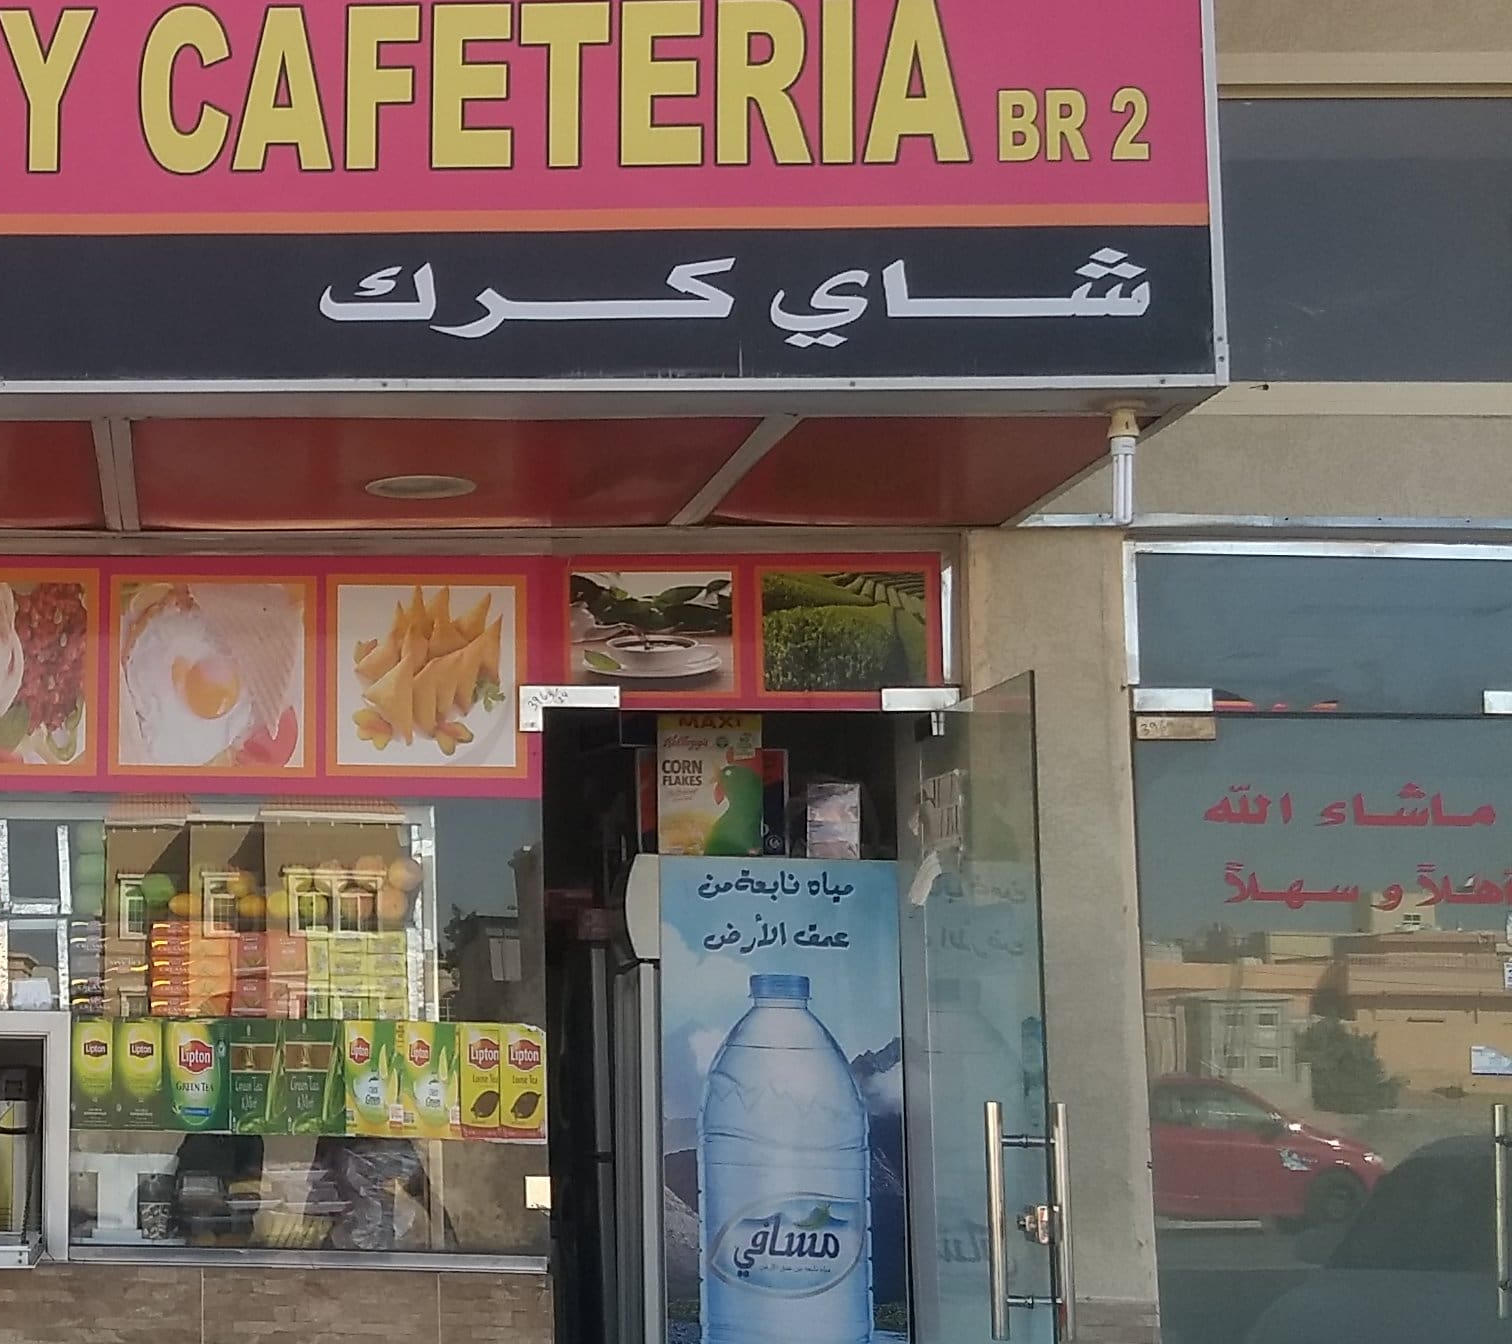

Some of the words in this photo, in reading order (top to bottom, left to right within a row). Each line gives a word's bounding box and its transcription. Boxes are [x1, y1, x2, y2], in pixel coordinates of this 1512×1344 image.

[995, 87, 1090, 163] BR
[1109, 85, 1151, 163] 2
[318, 256, 738, 337] كرك
[769, 244, 1152, 349] شاي
[662, 759, 702, 774] CORN
[662, 775, 702, 786] FLAKES
[1314, 782, 1497, 827] ماشاء
[698, 874, 734, 899] من
[735, 869, 800, 901] نابعة
[807, 871, 855, 903] مياه
[703, 913, 787, 954] الأرض
[793, 923, 850, 948] عمق
[85, 1044, 106, 1055] Lipton
[131, 1045, 152, 1056] Lipton
[180, 1049, 211, 1067] Lipton
[351, 1046, 369, 1059] Lipton
[410, 1048, 429, 1059] Lipton
[470, 1047, 499, 1065] Lipton
[510, 1047, 539, 1065] Lipton
[733, 1212, 840, 1278] مسافي
